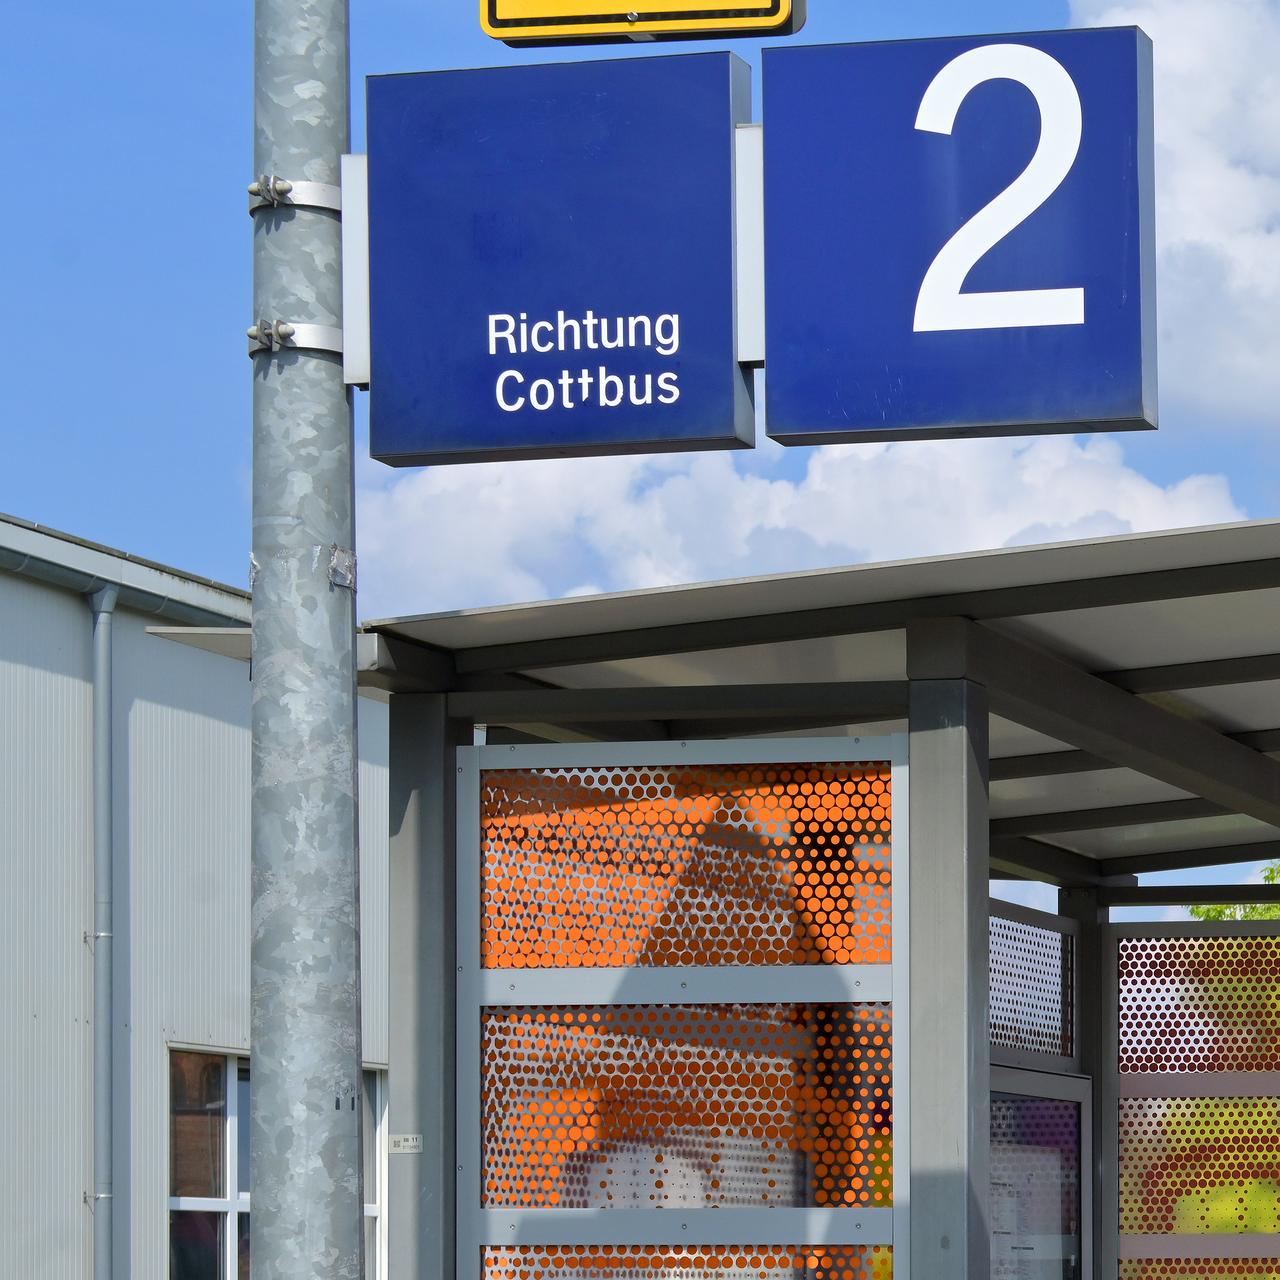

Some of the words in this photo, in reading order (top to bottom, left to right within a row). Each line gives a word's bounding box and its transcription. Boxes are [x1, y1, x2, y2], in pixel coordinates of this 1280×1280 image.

[913, 43, 1085, 333] 2
[488, 310, 680, 356] Richtung
[495, 366, 680, 412] Cottbus
